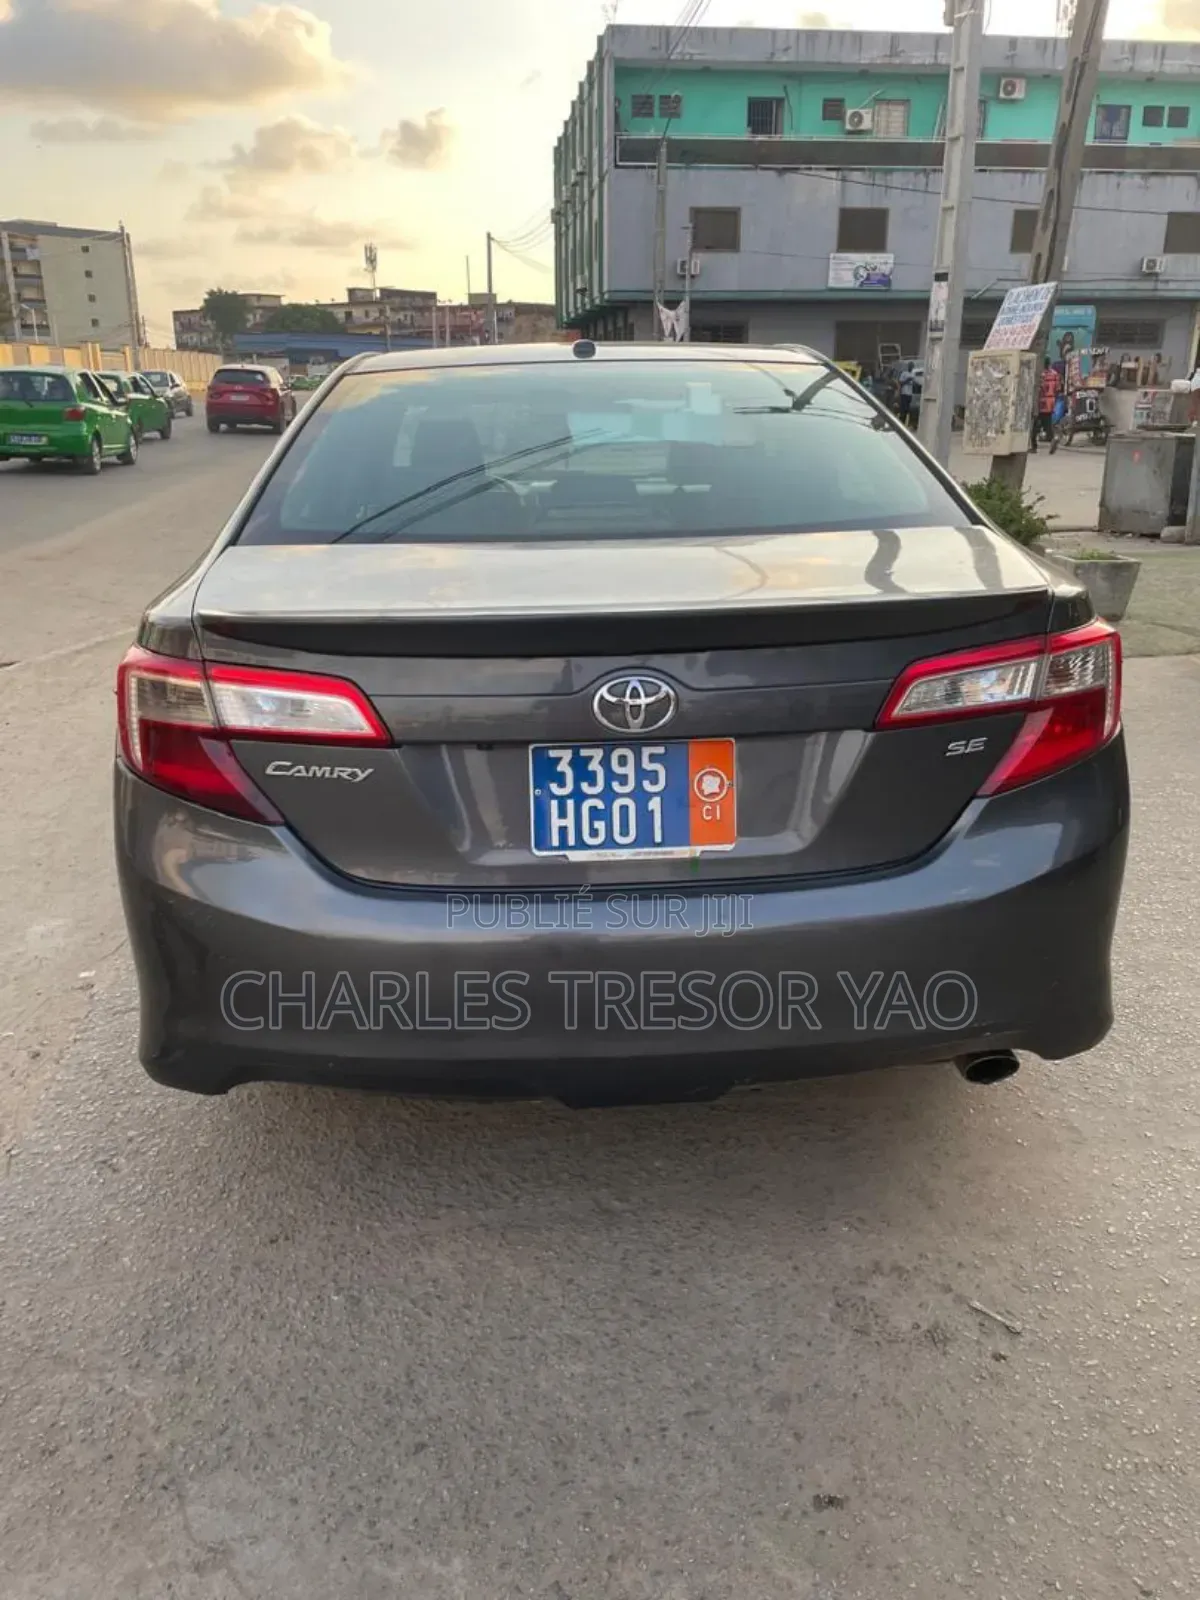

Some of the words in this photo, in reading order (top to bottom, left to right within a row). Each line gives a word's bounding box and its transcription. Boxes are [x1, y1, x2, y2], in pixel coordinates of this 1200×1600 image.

[946, 737, 988, 756] SE
[265, 761, 374, 782] CAMRY
[548, 746, 666, 795] 3395
[551, 797, 663, 847] HG01
[702, 805, 721, 820] CI
